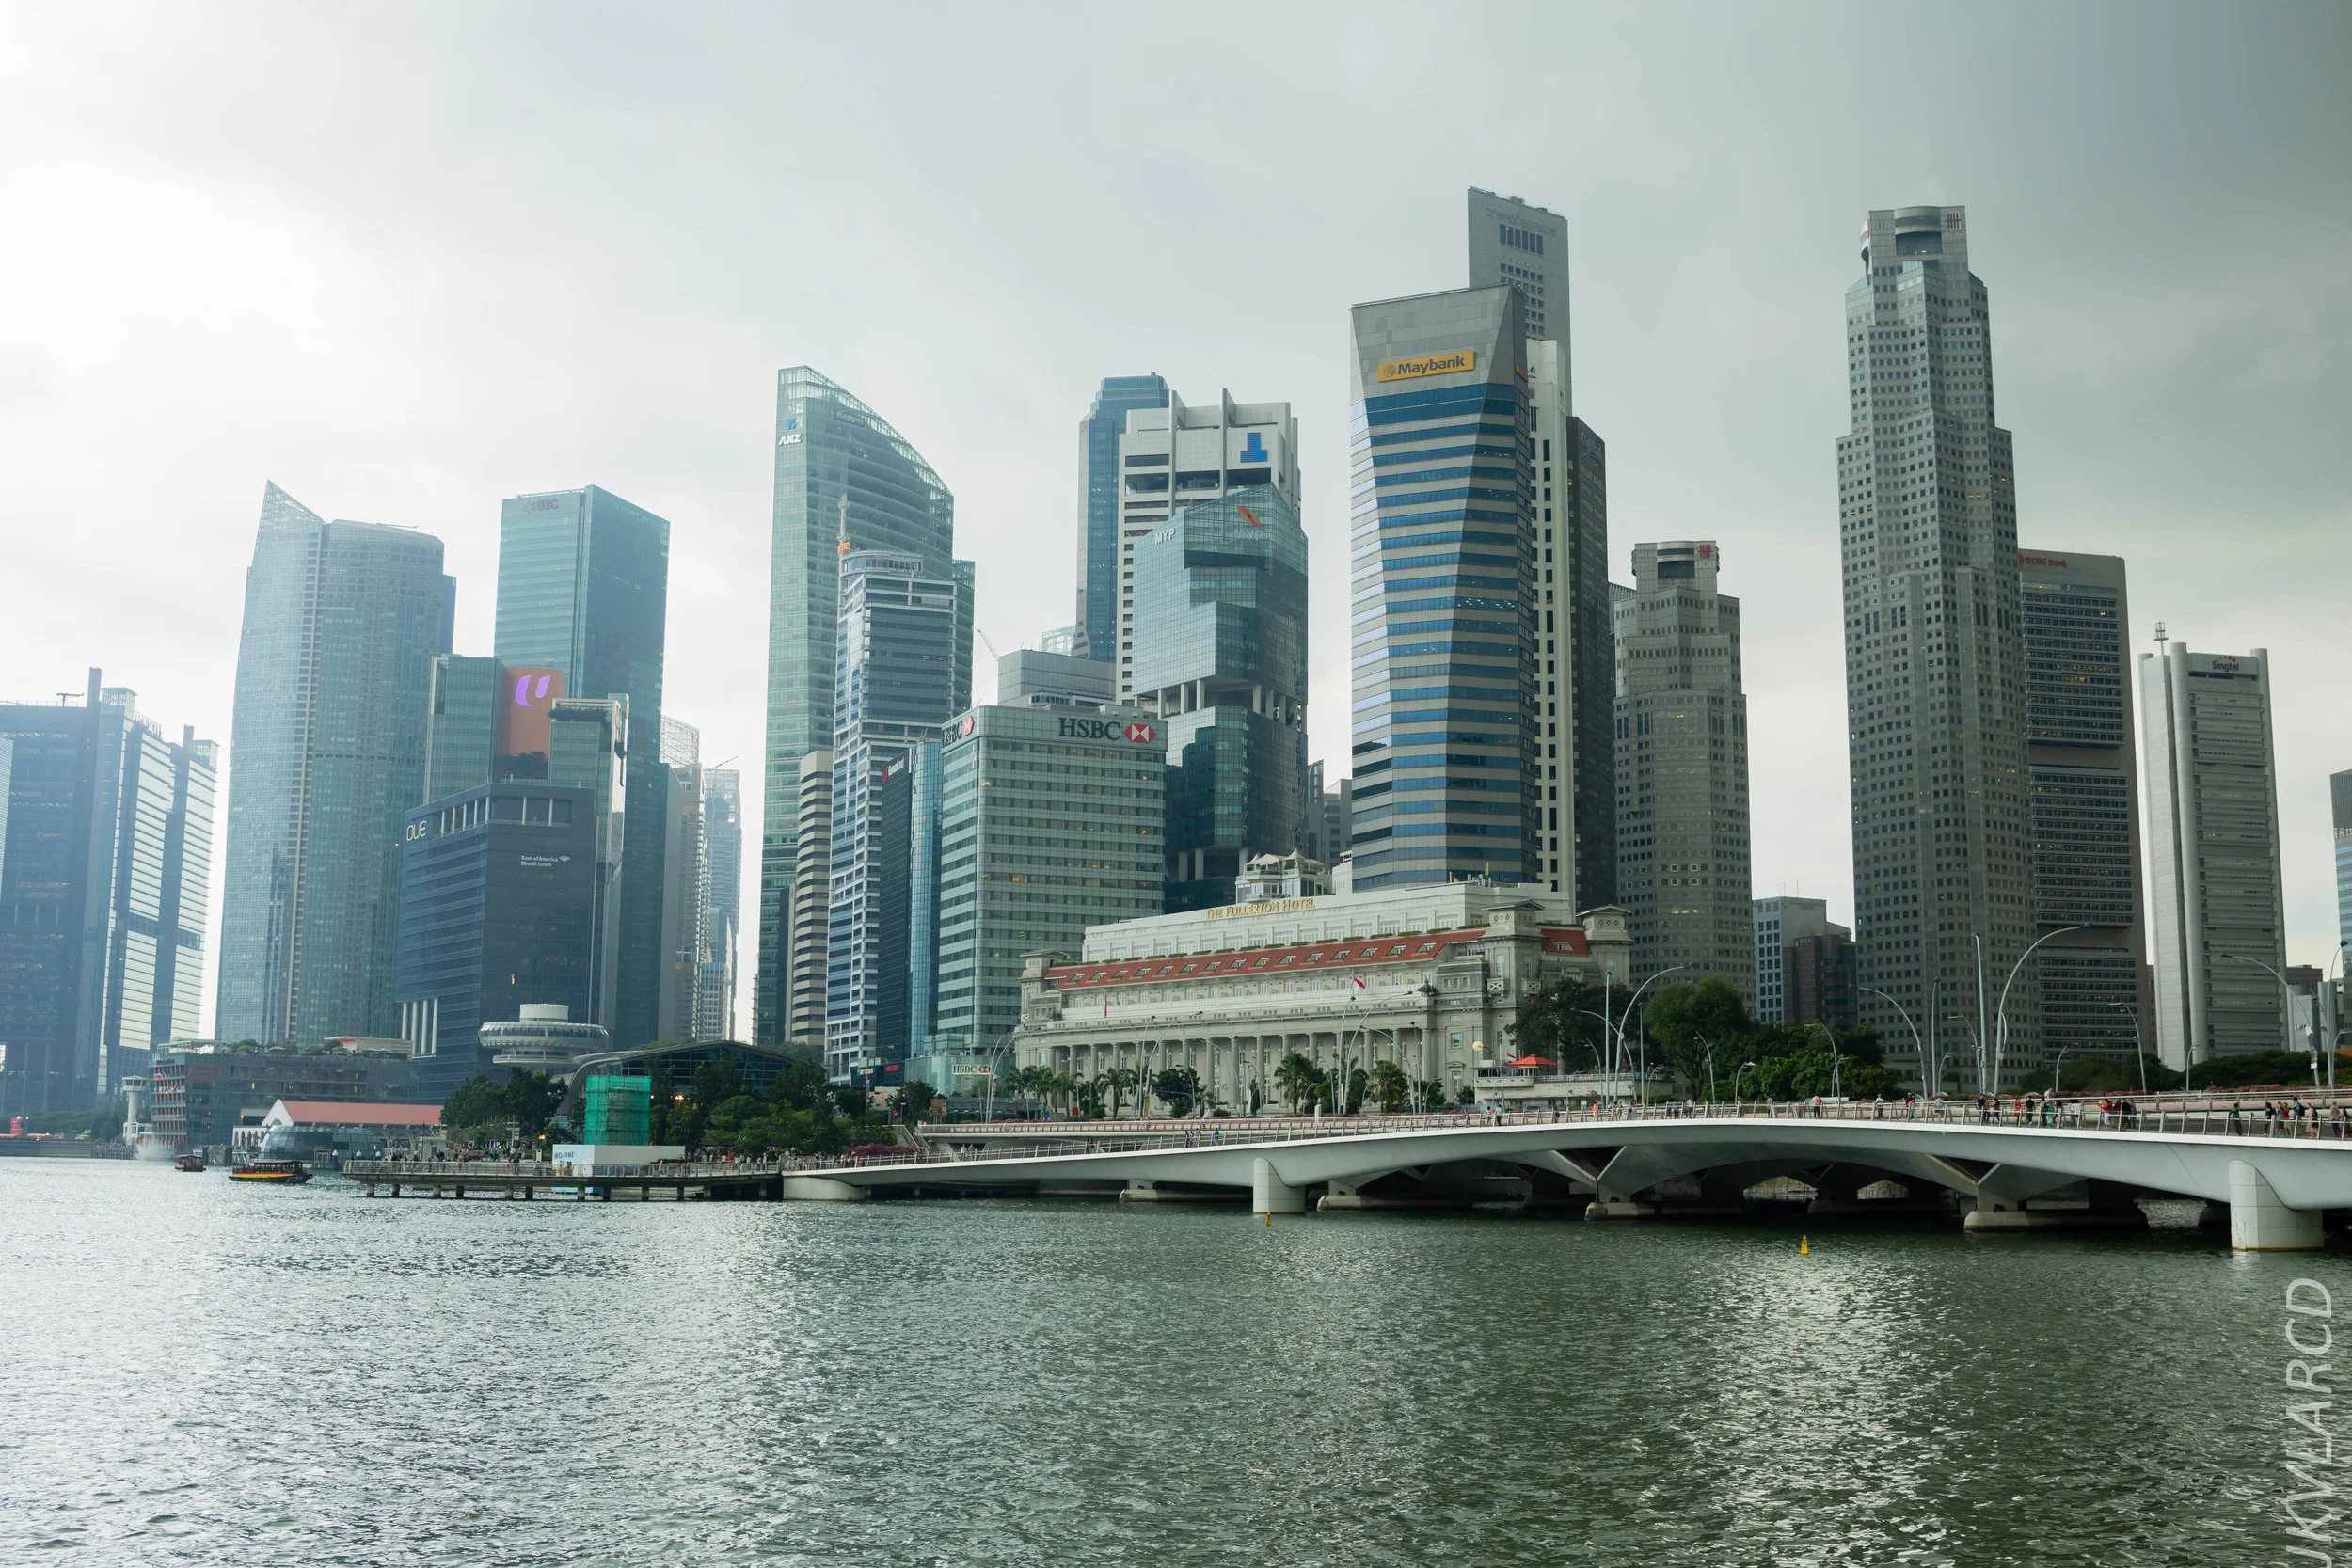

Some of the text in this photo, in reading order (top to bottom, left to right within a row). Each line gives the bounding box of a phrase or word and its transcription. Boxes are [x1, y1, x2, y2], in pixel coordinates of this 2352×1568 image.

[1398, 355, 1465, 374] Maybank
[778, 433, 803, 447] ANZ
[1153, 528, 1176, 545] MYP
[1233, 528, 1264, 541] MYP
[2212, 660, 2240, 672] Singtel
[1058, 717, 1122, 741] HSBC
[405, 820, 427, 842] OUE
[1205, 896, 1315, 920] THE FULLERTON HOTEL
[953, 1065, 977, 1074] HSBC
